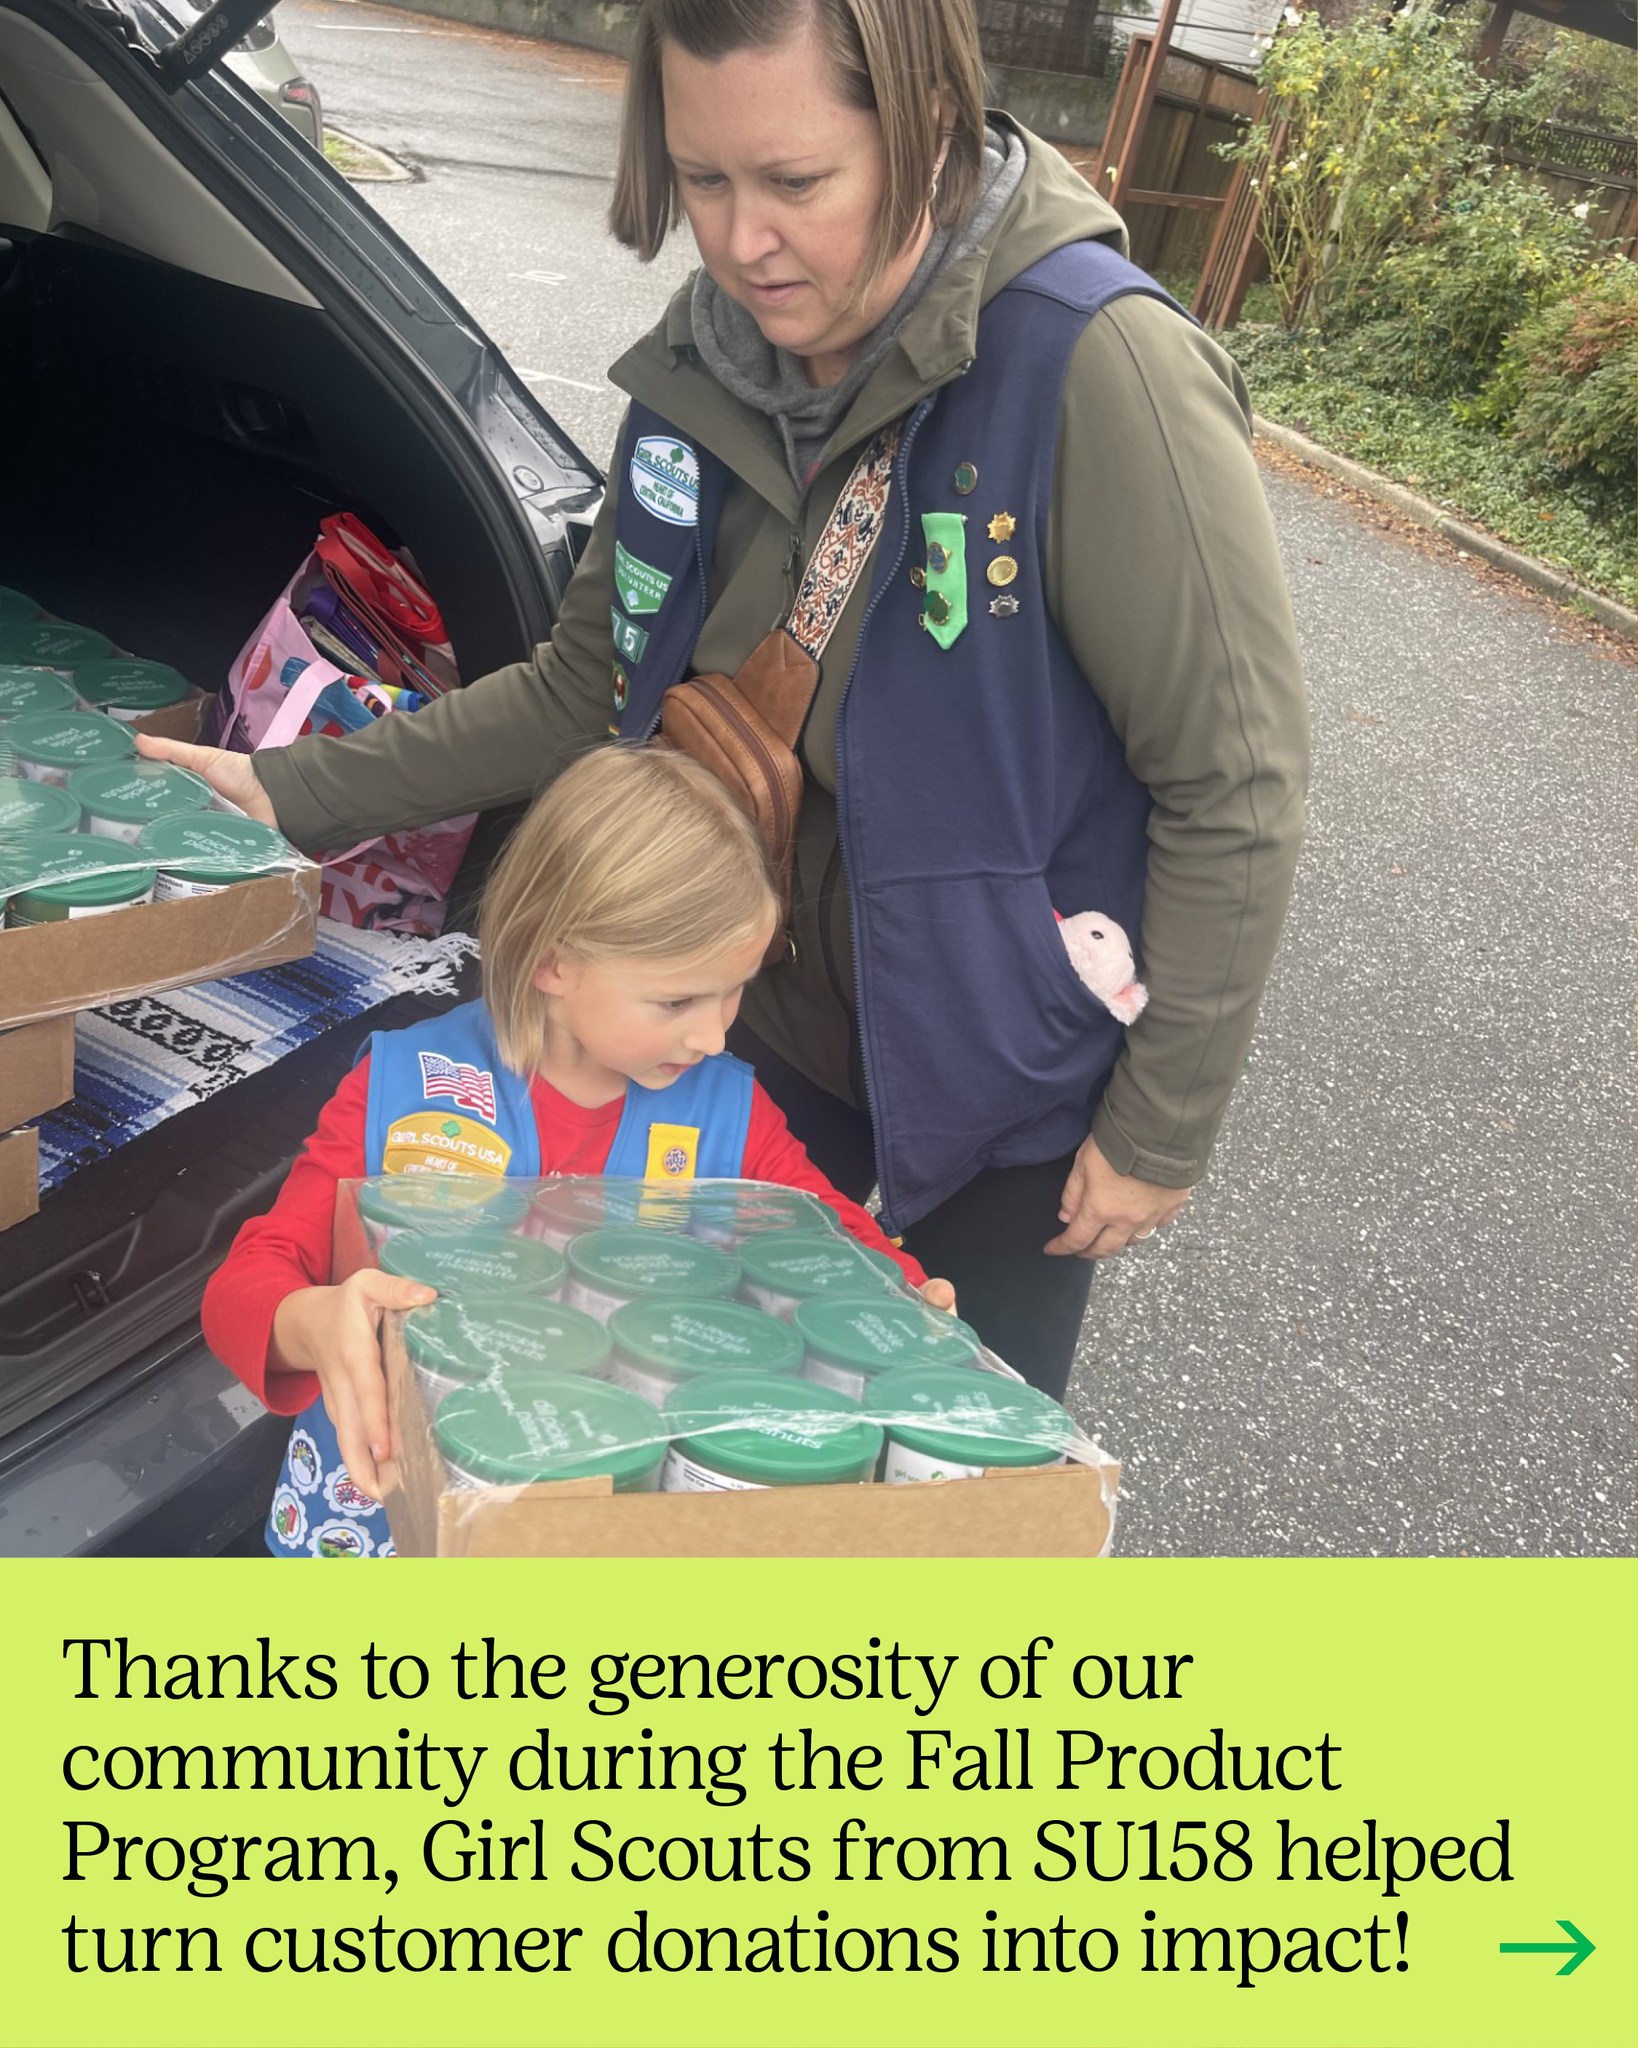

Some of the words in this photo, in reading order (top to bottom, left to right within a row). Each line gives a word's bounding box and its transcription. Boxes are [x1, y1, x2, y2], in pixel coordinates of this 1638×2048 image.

[655, 455, 690, 484] SCOUTS
[624, 560, 655, 585] SCOUTS
[392, 1131, 419, 1144] GIRL
[421, 1132, 477, 1157] SCOUTS
[477, 1146, 503, 1166] USA
[424, 1155, 447, 1169] HEART
[446, 1161, 459, 1171] OF
